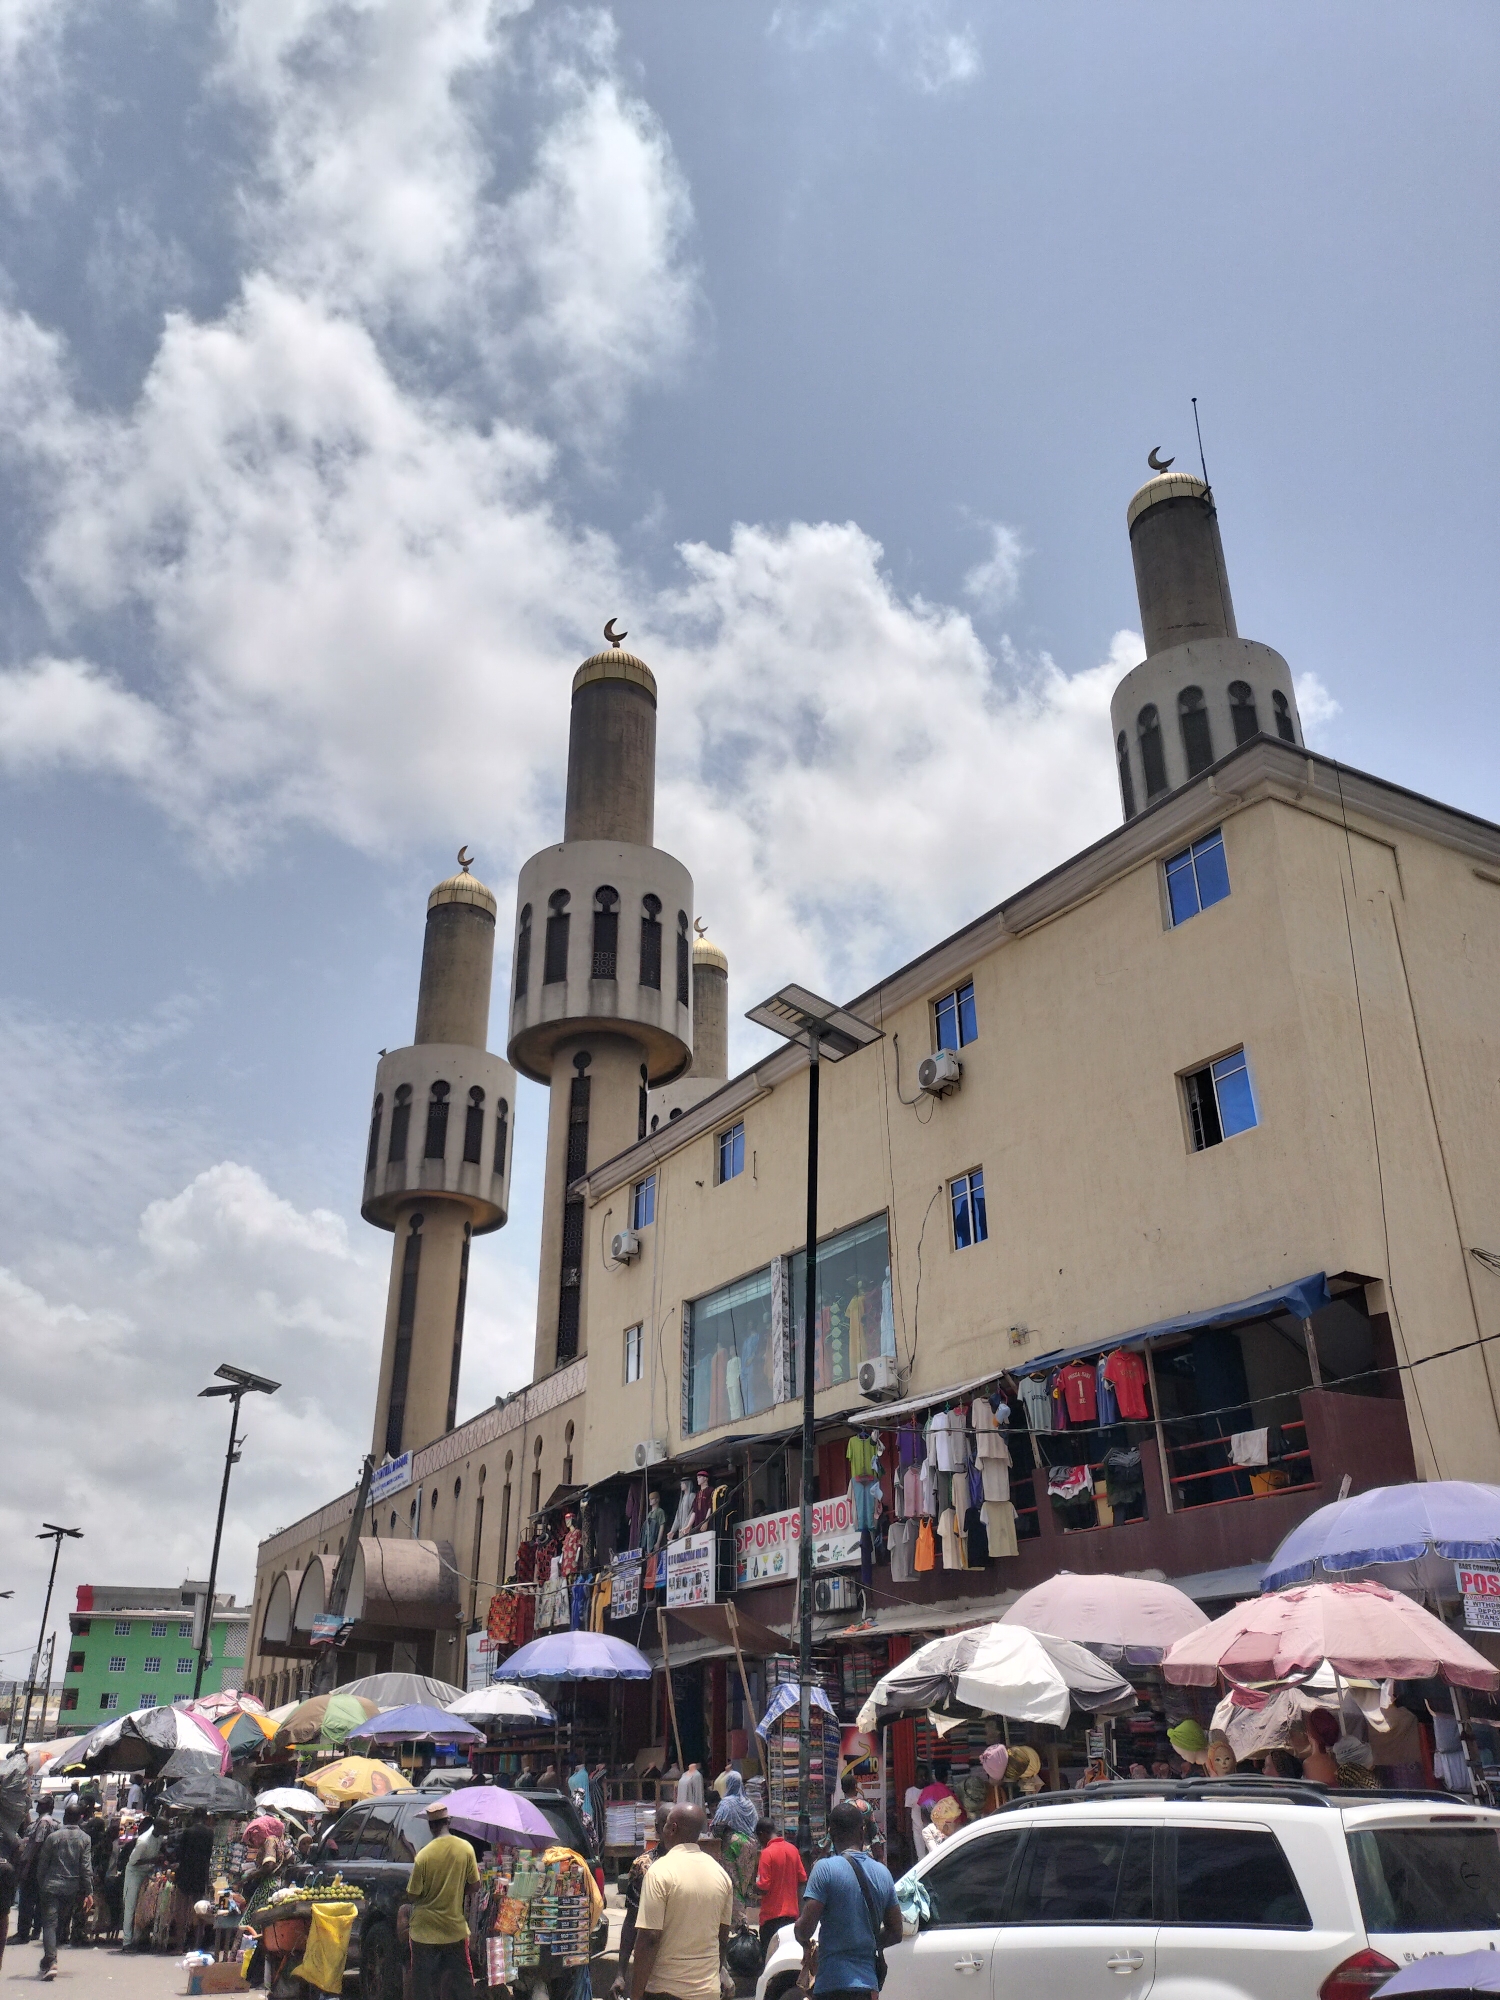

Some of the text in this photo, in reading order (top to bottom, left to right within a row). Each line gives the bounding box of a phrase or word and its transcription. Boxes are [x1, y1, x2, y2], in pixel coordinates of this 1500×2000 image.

[734, 1513, 801, 1553] SPORTS
[1460, 1572, 1500, 1595] POS
[869, 1756, 879, 1773] 10
